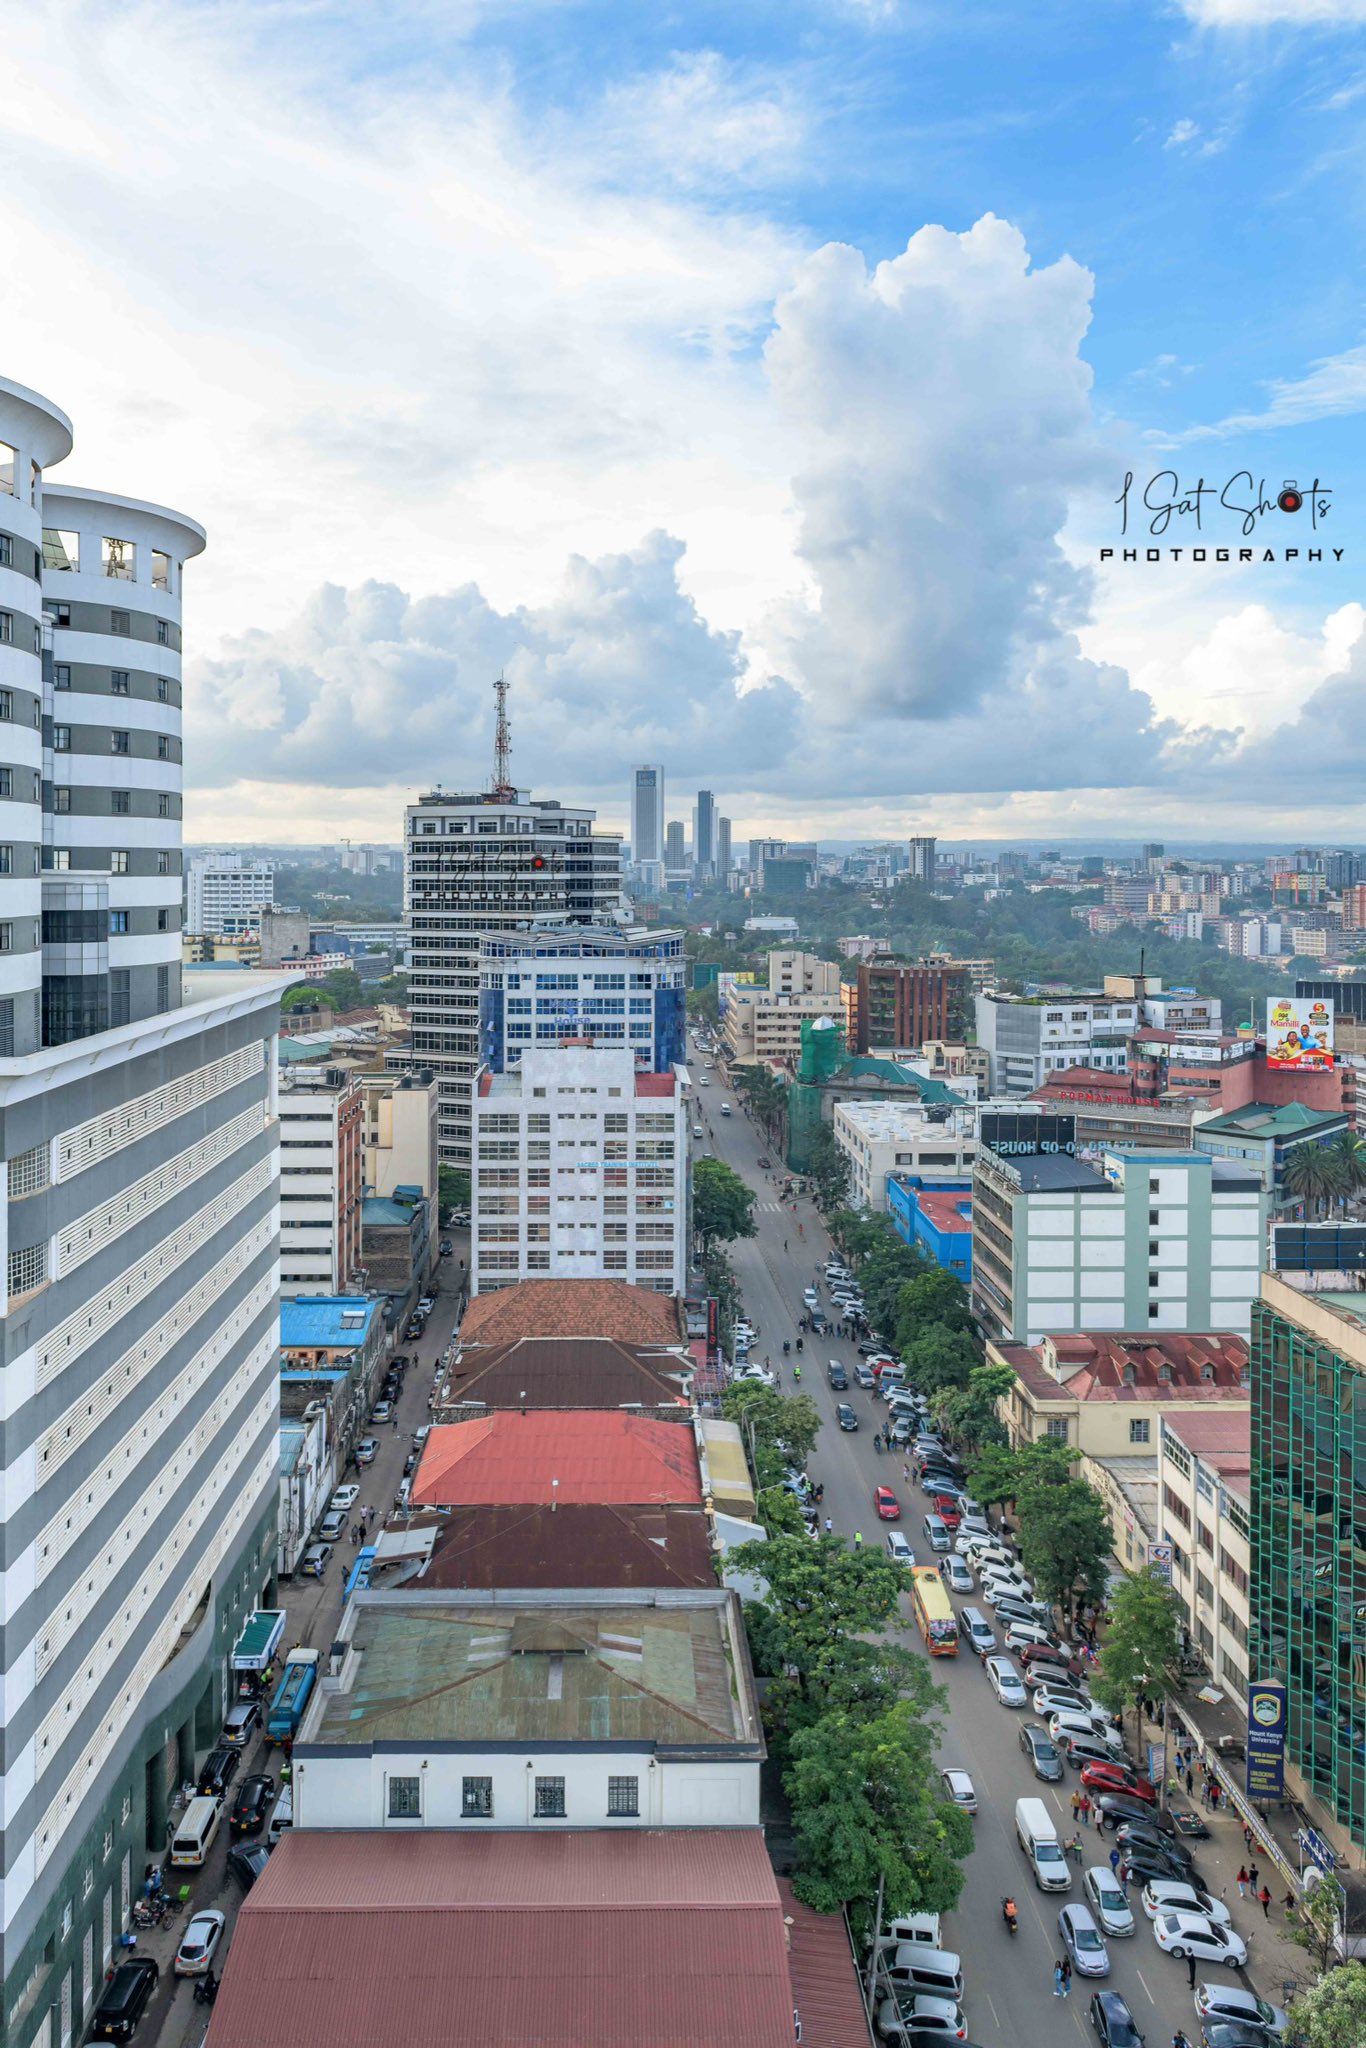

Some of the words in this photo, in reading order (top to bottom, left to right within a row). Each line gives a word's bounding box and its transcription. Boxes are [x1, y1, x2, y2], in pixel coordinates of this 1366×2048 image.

[554, 1017, 591, 1025] House
[1060, 1091, 1112, 1103] POPMAN
[1117, 1096, 1161, 1108] HOUSE
[1251, 1736, 1280, 1745] University
